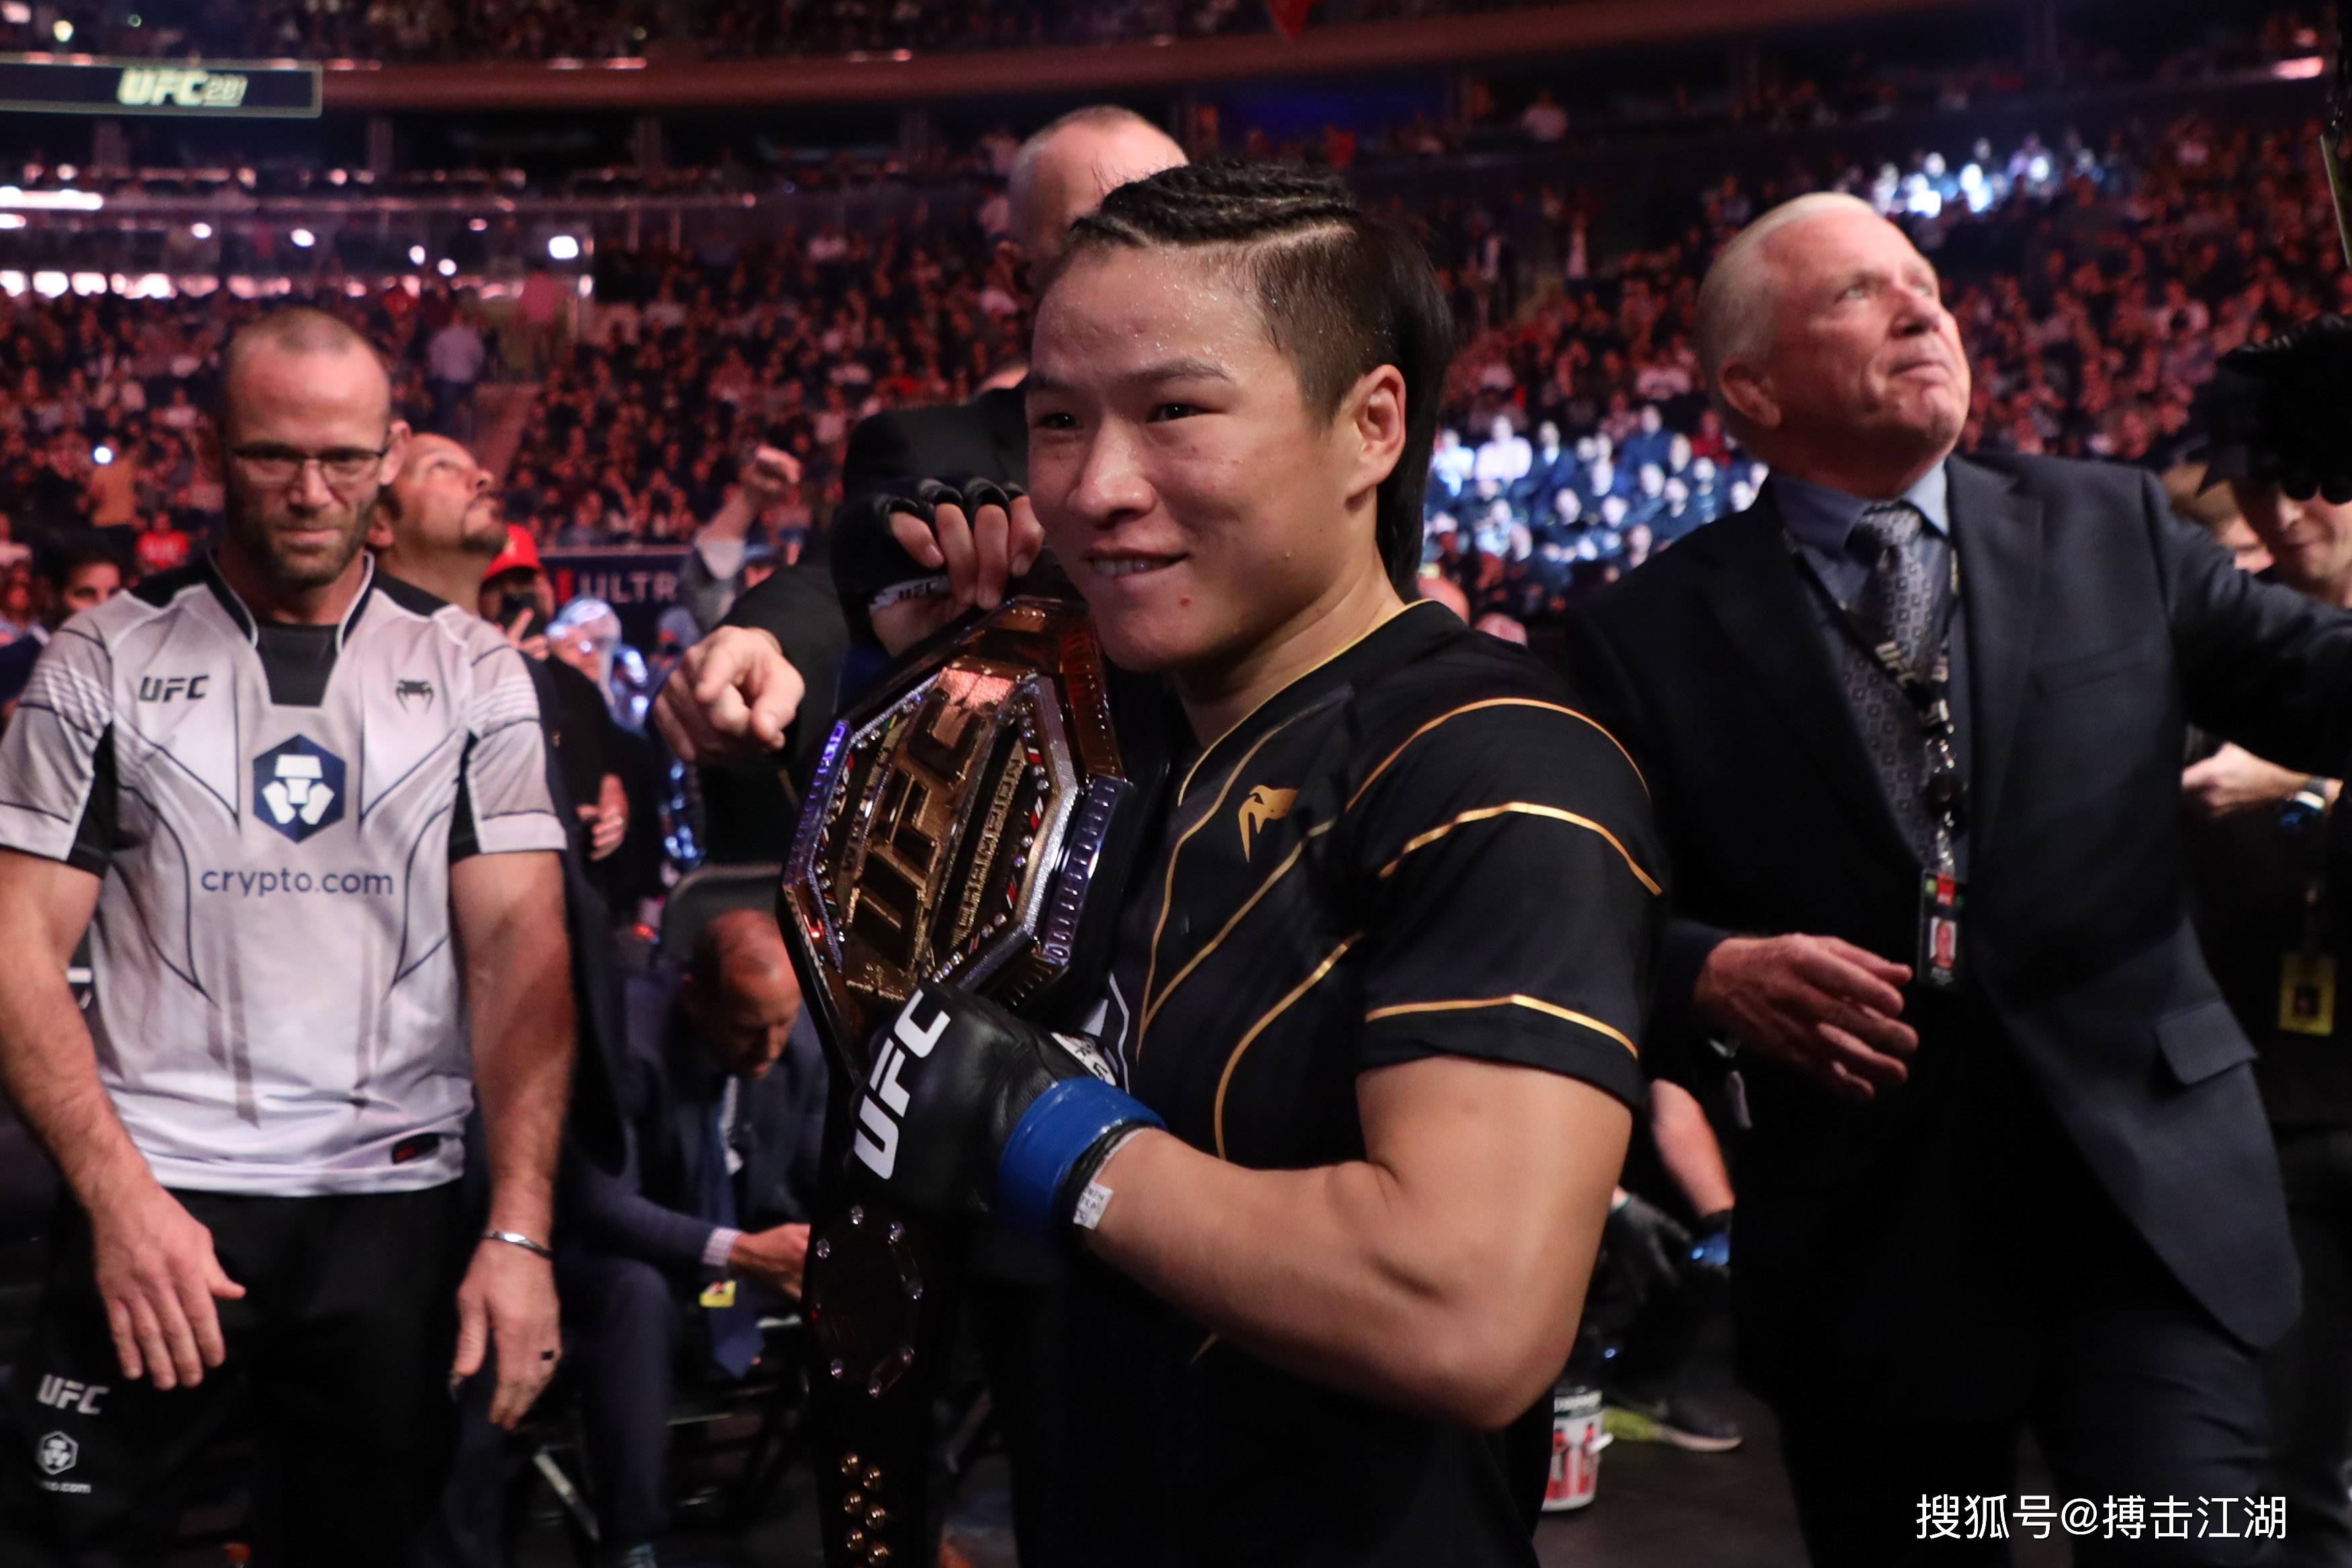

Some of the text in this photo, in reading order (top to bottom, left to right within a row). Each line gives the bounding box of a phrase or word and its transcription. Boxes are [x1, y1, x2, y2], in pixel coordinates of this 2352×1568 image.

[117, 69, 208, 106] UFC
[578, 571, 678, 603] ULTR
[139, 675, 210, 703] UFC
[201, 867, 394, 894] crypto.com
[854, 988, 952, 1180] UFC
[37, 1374, 110, 1415] UFC
